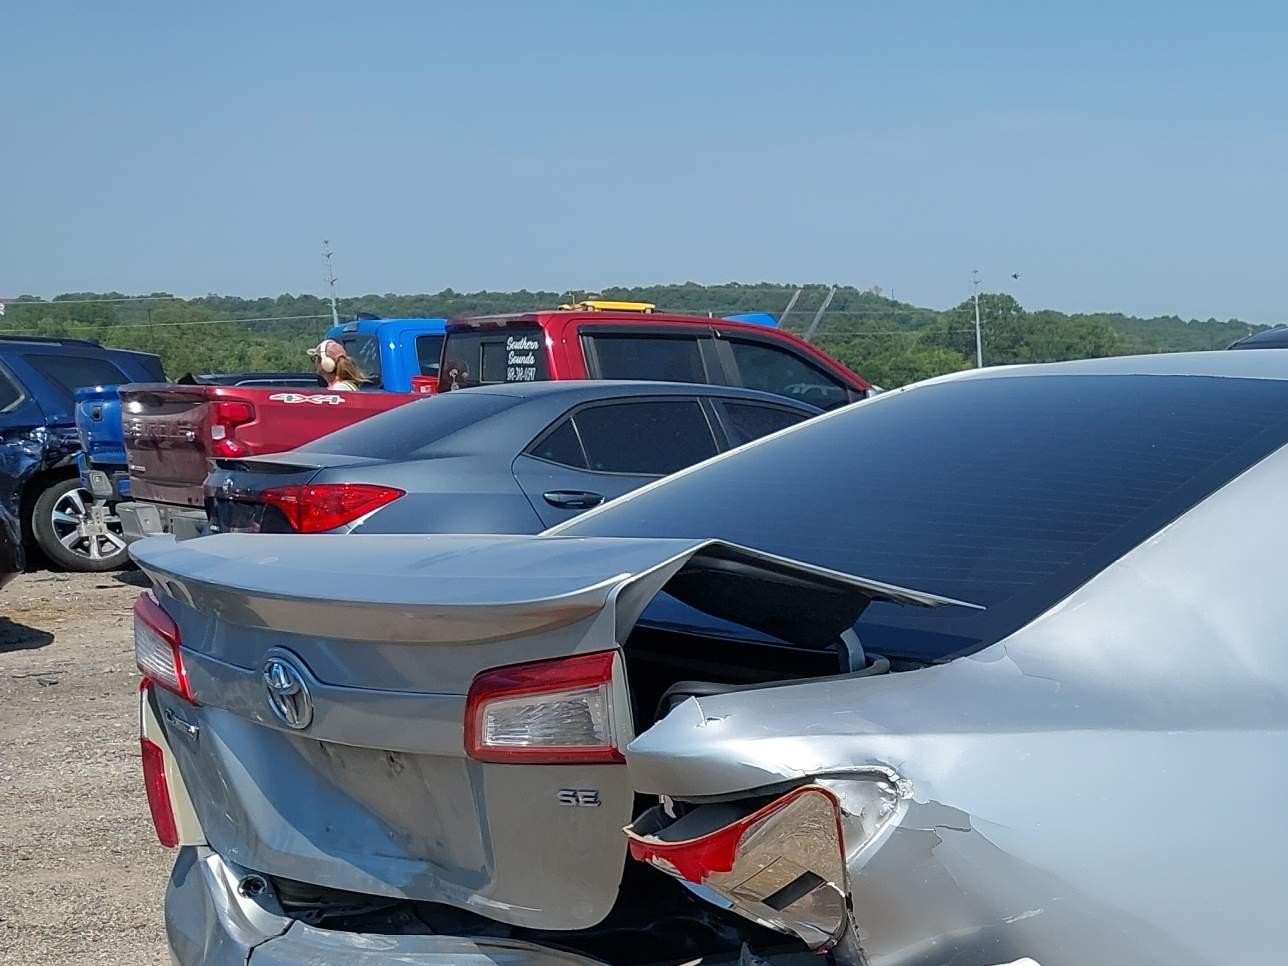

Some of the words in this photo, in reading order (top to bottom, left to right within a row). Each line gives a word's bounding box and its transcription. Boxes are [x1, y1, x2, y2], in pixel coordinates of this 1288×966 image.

[506, 336, 539, 351] Southern
[508, 351, 535, 365] Sounds
[556, 789, 601, 807] SE
